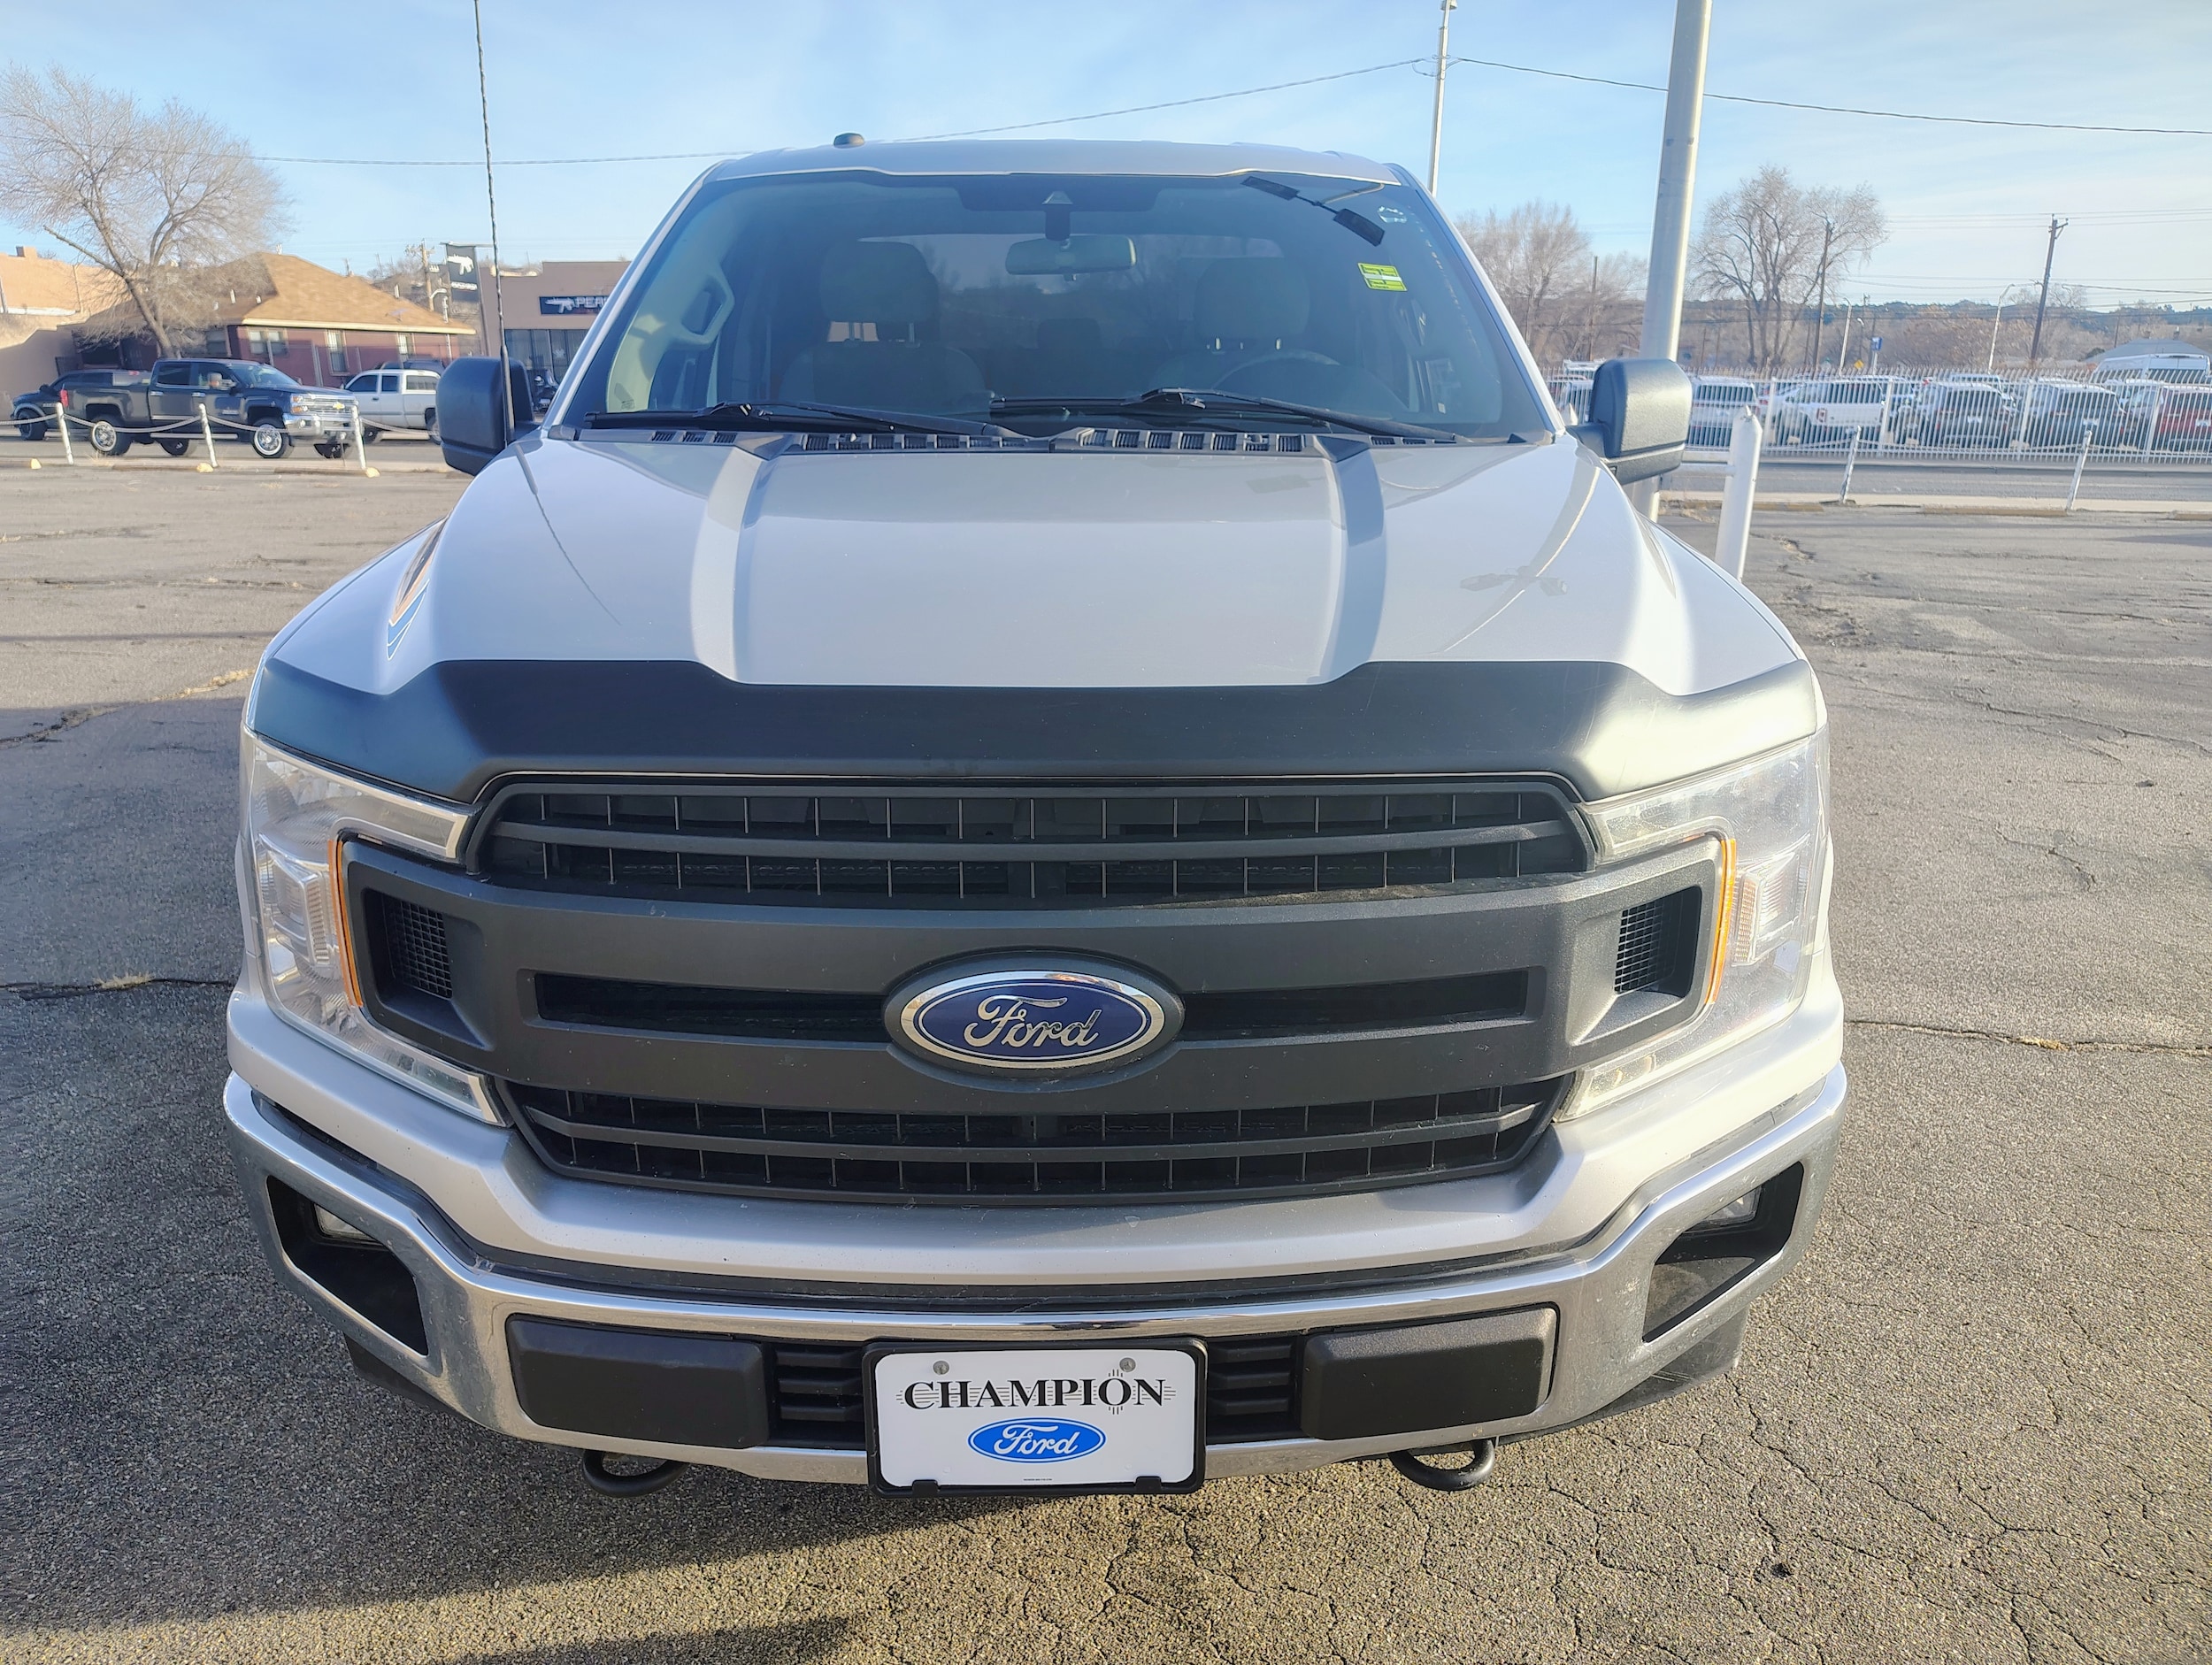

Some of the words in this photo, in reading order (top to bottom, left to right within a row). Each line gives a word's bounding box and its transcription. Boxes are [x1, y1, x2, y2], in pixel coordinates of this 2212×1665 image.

[964, 994, 1102, 1047] Ford
[903, 1377, 1166, 1409] CHAMPION
[993, 1424, 1081, 1454] Ford
